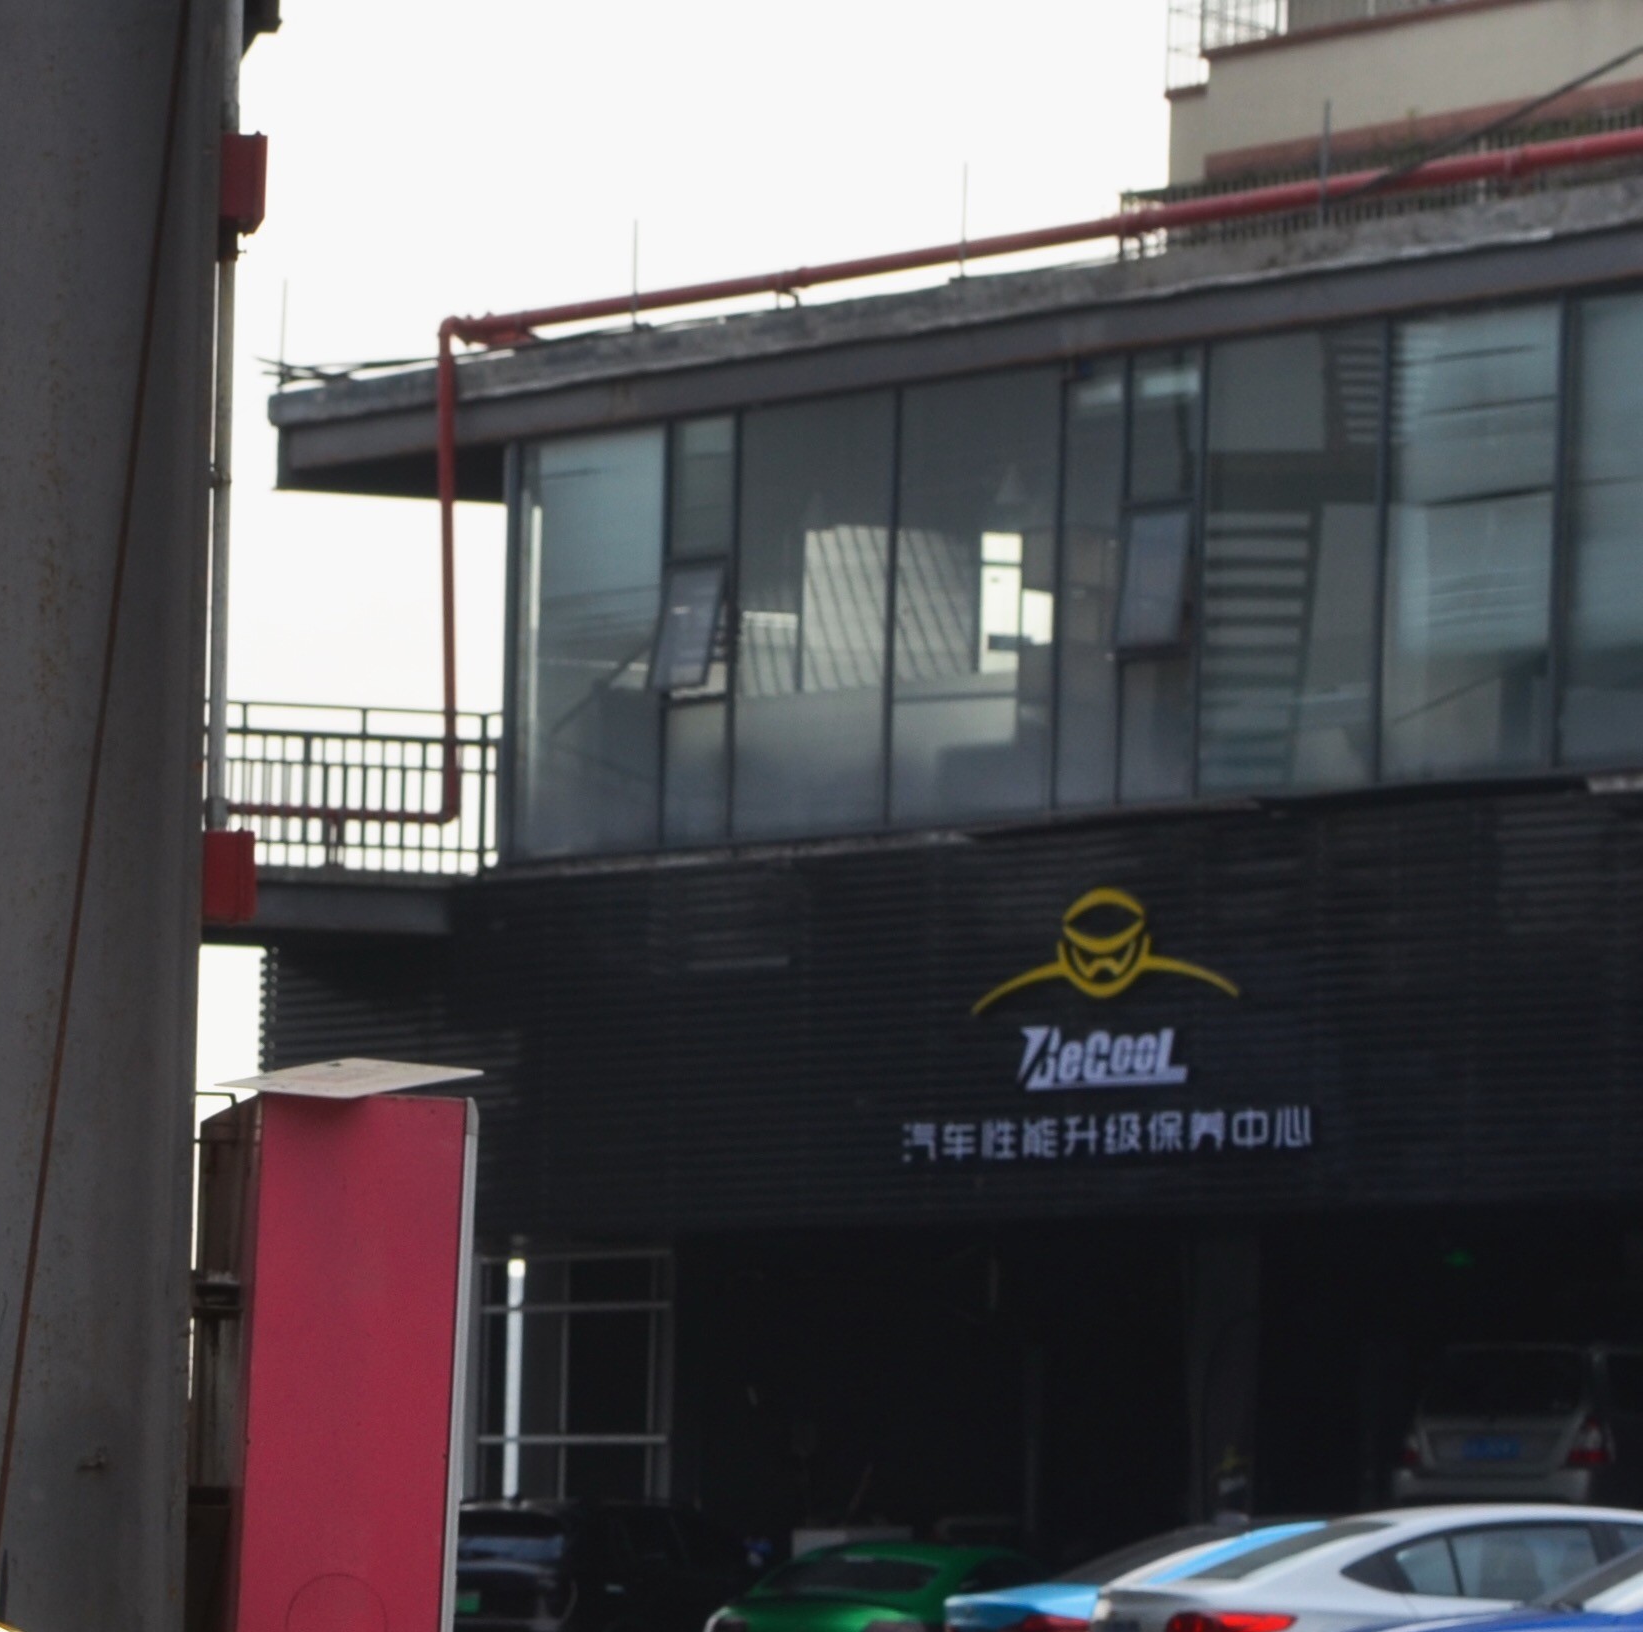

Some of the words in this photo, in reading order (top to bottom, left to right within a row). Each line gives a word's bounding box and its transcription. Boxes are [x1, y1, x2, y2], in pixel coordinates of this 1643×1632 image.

[901, 1105, 1312, 1163] 汽车性能升级保养中心
